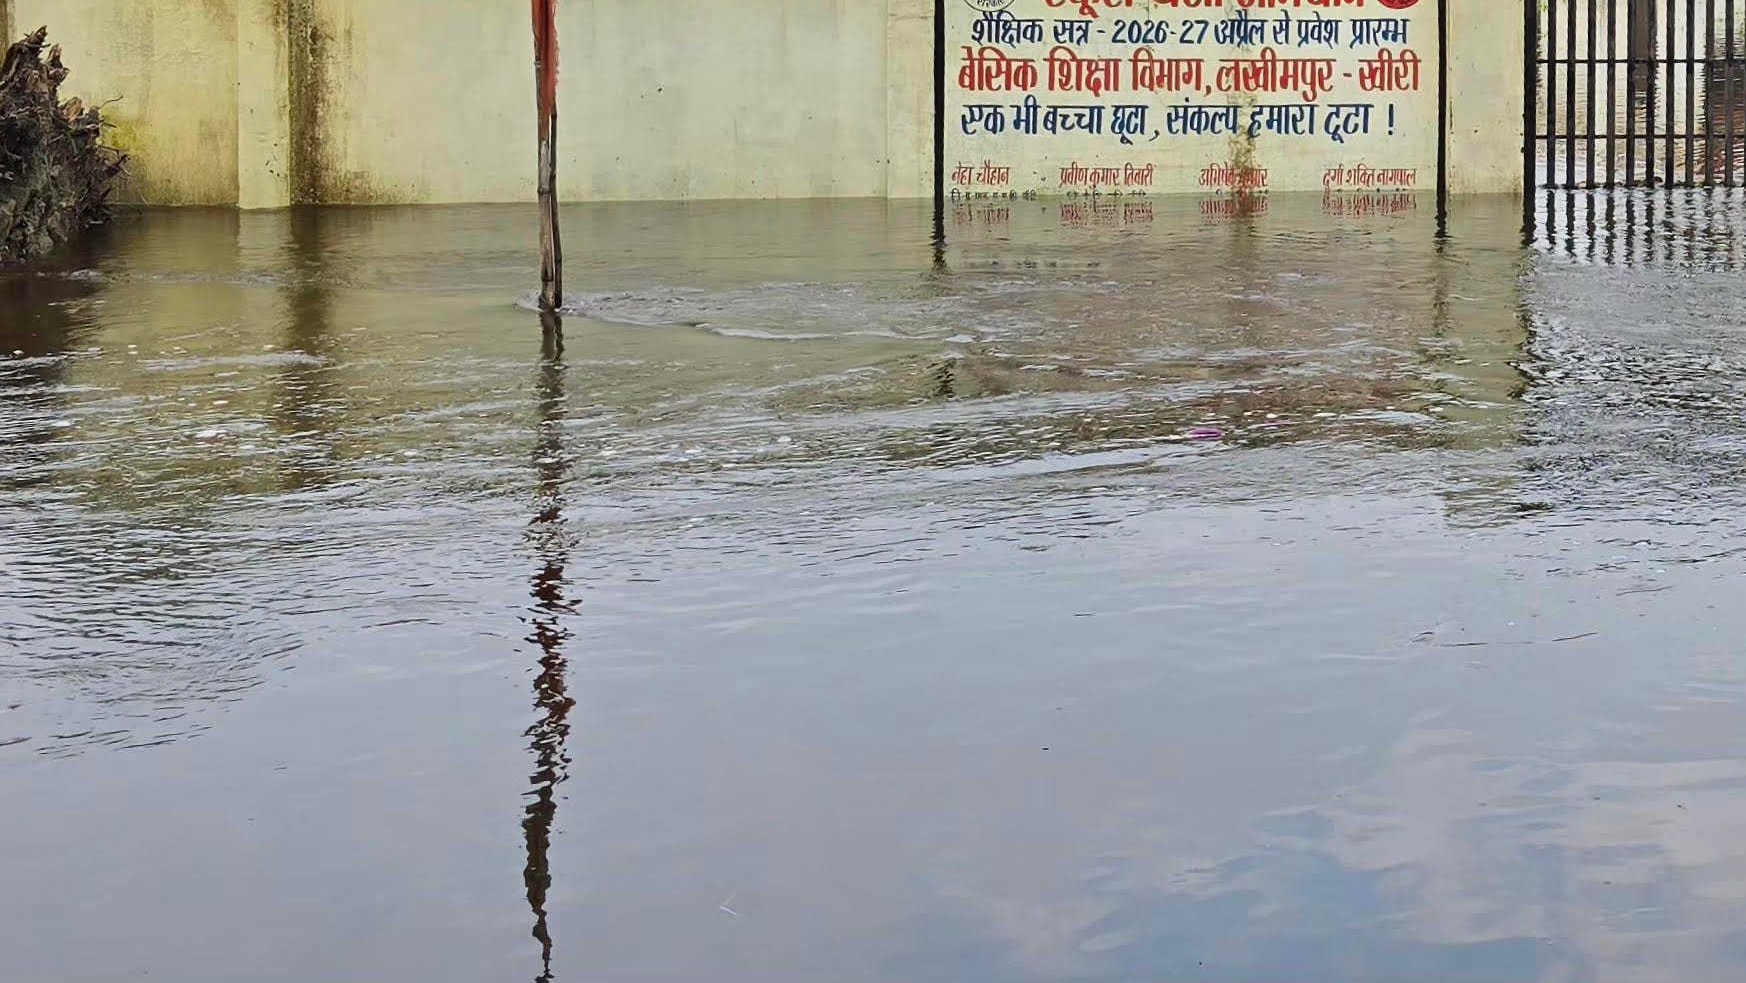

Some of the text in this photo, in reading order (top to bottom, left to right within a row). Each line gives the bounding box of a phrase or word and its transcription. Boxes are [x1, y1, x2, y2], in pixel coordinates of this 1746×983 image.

[972, 10, 1044, 48] शैक्षिक
[1053, 19, 1093, 45] सत्र
[1112, 19, 1209, 44] 2026-27
[1214, 8, 1269, 47] अप्रैल
[1273, 9, 1292, 44] से
[1297, 11, 1342, 48] प्रवेश
[1350, 19, 1411, 48] प्रारम्भ
[958, 46, 1039, 91] बेसिक
[1043, 46, 1122, 97] शिक्षा
[1216, 47, 1337, 102] लखीमपुर
[1358, 48, 1422, 91] खीरी
[961, 104, 1005, 135] एक
[1009, 94, 1042, 135] भी
[1043, 105, 1106, 135] बच्चा
[1167, 97, 1243, 135] संकल्प
[1248, 103, 1319, 139] हमारा
[951, 160, 1012, 186] नेहा चौहान
[1059, 161, 1155, 191] प्रवीण कुमार तिवारी
[1346, 163, 1375, 186] शक्ति
[1376, 168, 1417, 187] नागपाल
